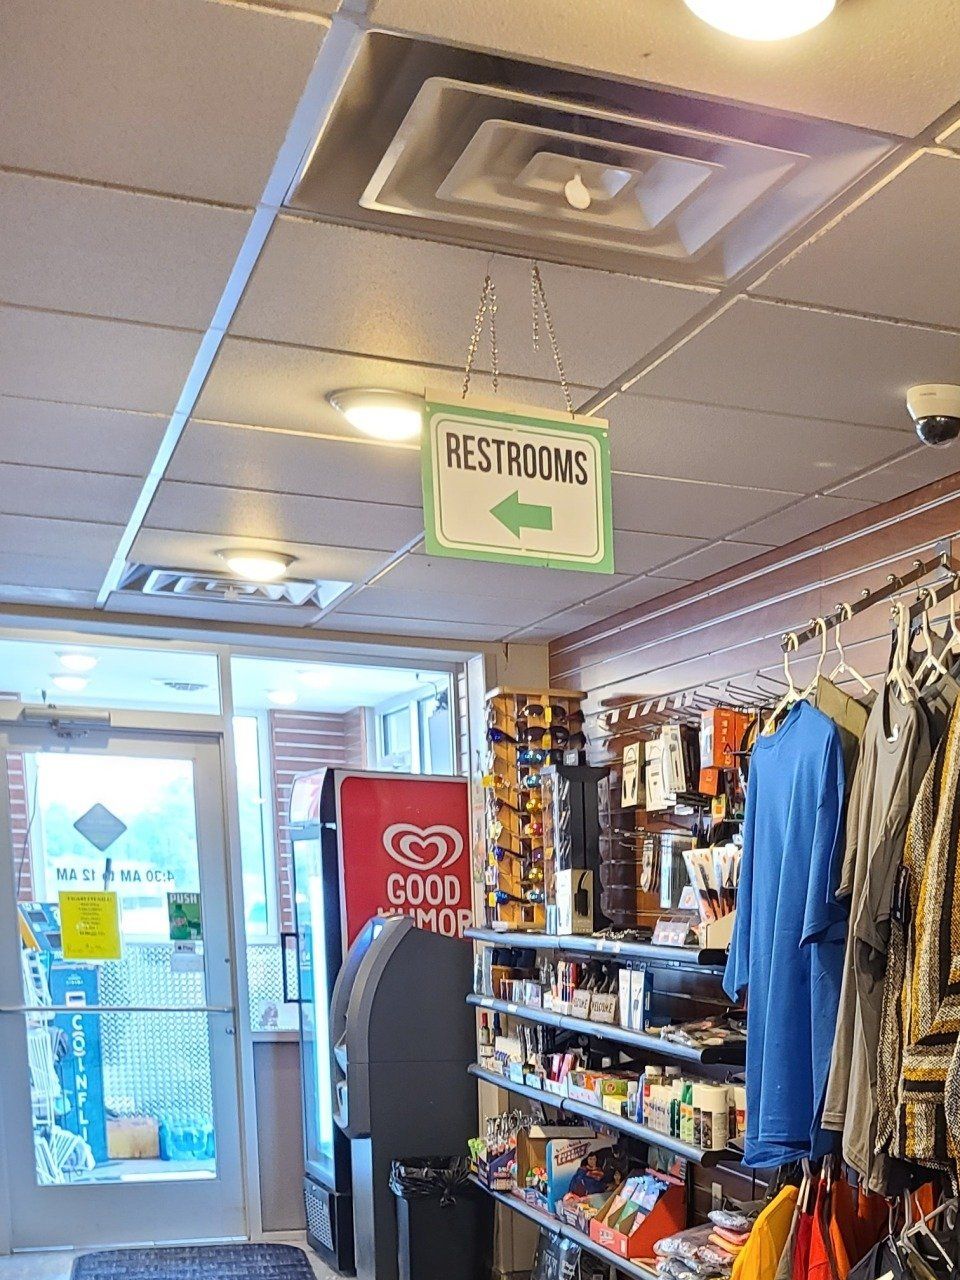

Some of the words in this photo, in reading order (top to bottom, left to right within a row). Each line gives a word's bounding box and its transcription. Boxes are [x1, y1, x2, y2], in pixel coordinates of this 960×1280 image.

[446, 431, 588, 486] RESTROOMS
[169, 893, 198, 904] PUSH
[387, 872, 461, 905] GOOD
